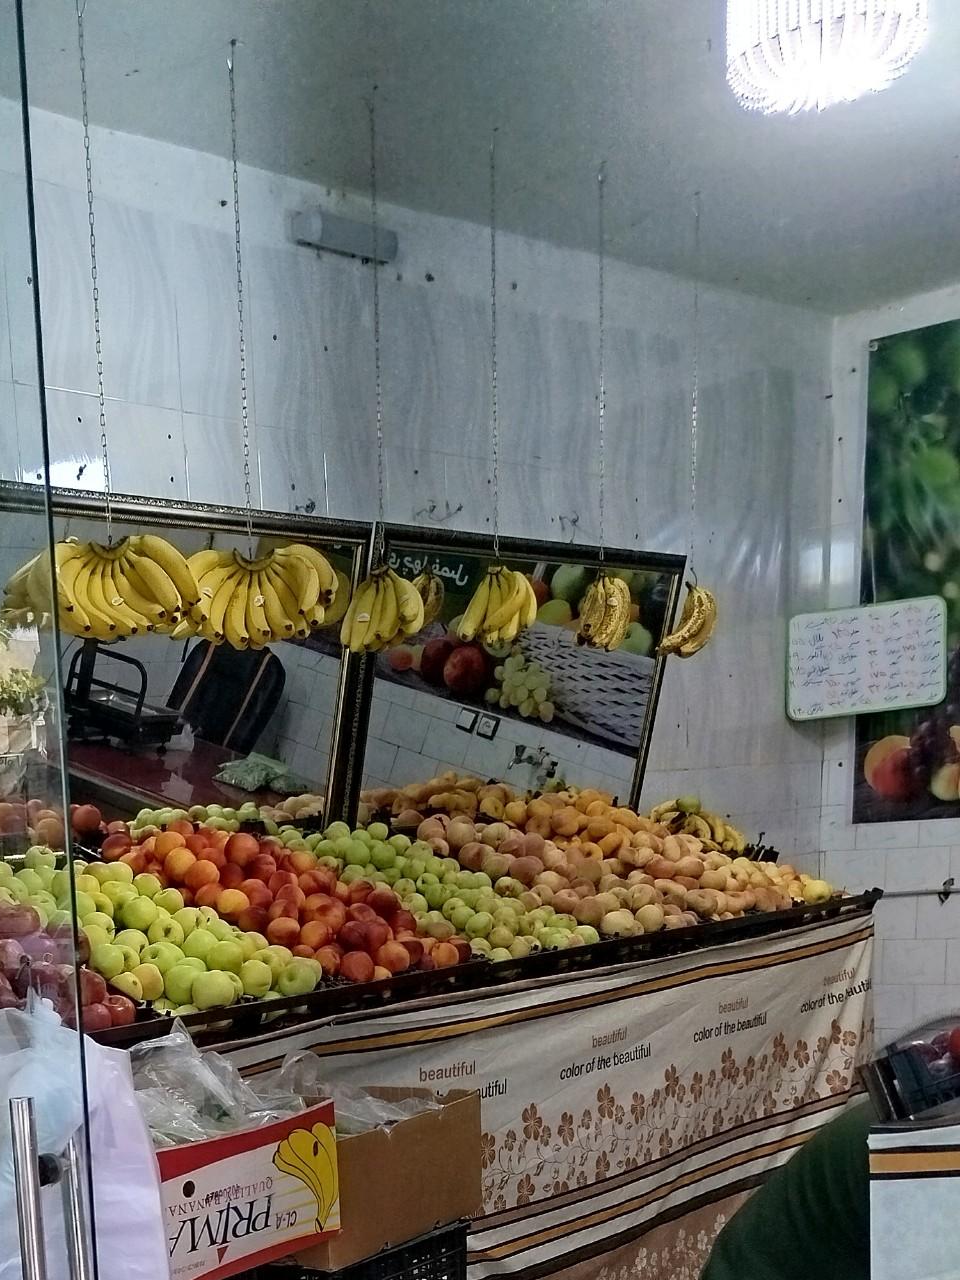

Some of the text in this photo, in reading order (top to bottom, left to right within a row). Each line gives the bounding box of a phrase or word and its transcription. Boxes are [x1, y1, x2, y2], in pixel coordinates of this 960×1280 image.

[718, 996, 749, 1015] beautiful
[827, 991, 844, 1006] the
[591, 1026, 629, 1049] beautiful
[693, 1012, 768, 1043] color of the beautiful
[419, 1060, 477, 1083] beautiful
[559, 1042, 652, 1081] color of the beautiful
[223, 1176, 274, 1204] QUALITY
